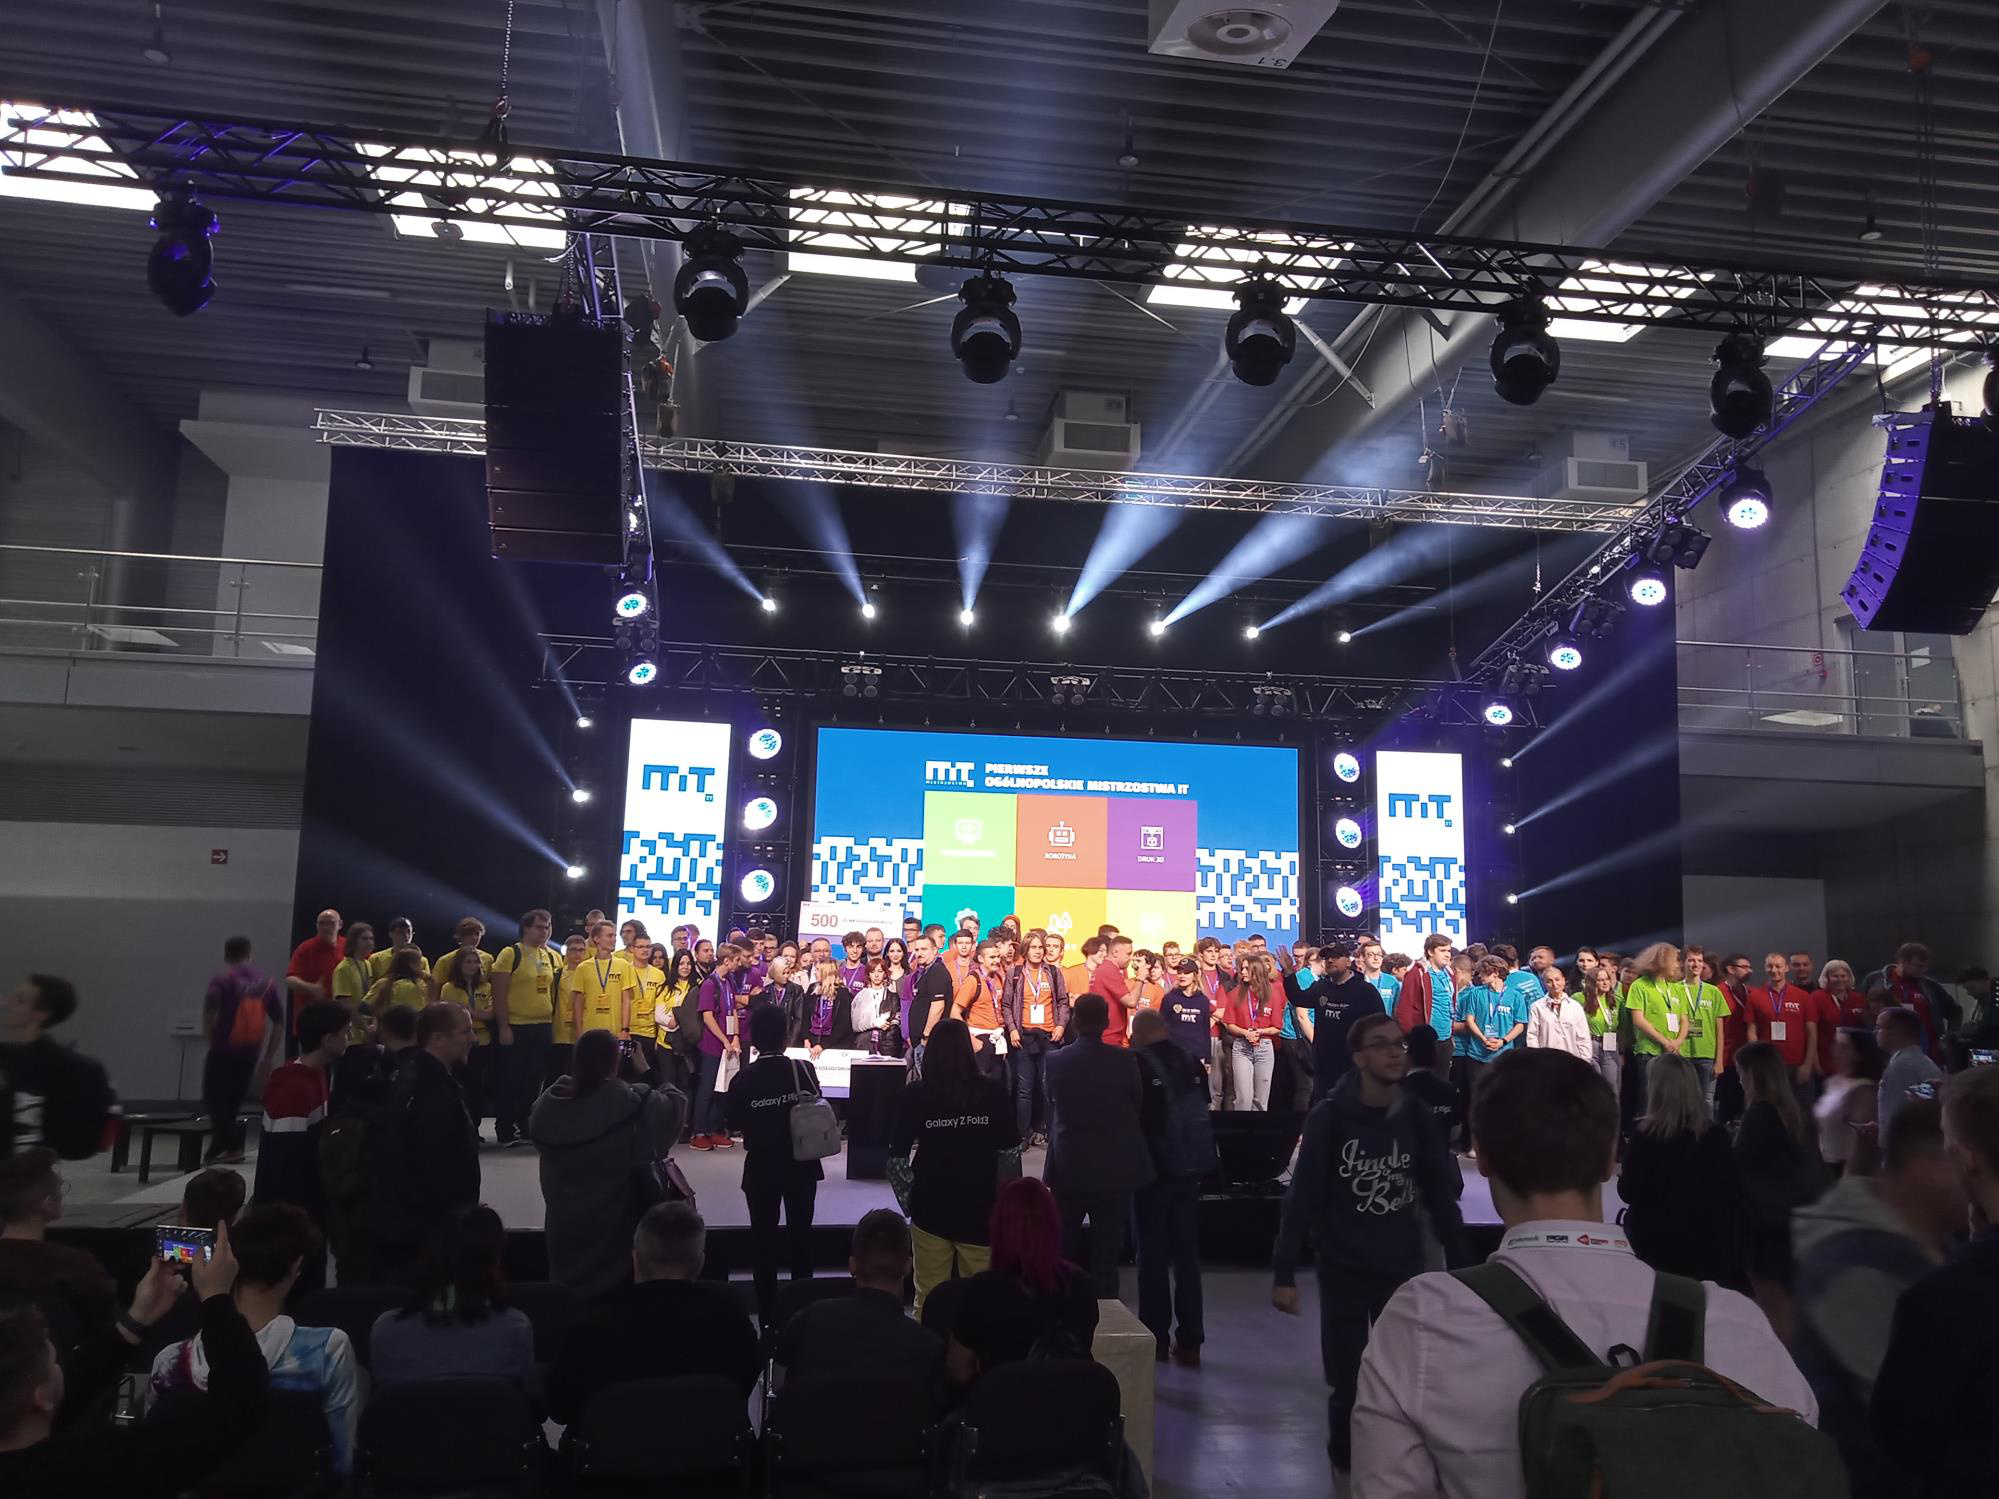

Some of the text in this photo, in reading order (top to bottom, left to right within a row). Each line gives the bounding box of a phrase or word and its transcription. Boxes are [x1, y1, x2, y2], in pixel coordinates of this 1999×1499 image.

[985, 763, 1048, 776] PIERWSZE
[985, 776, 1189, 795] OGÓLNOPOLSKIE MISTRZOSTWA IT
[811, 913, 839, 928] 500
[750, 1097, 781, 1108] Galaxy
[782, 1094, 788, 1103] Z
[925, 1115, 989, 1129] Galaxy Z Fold3
